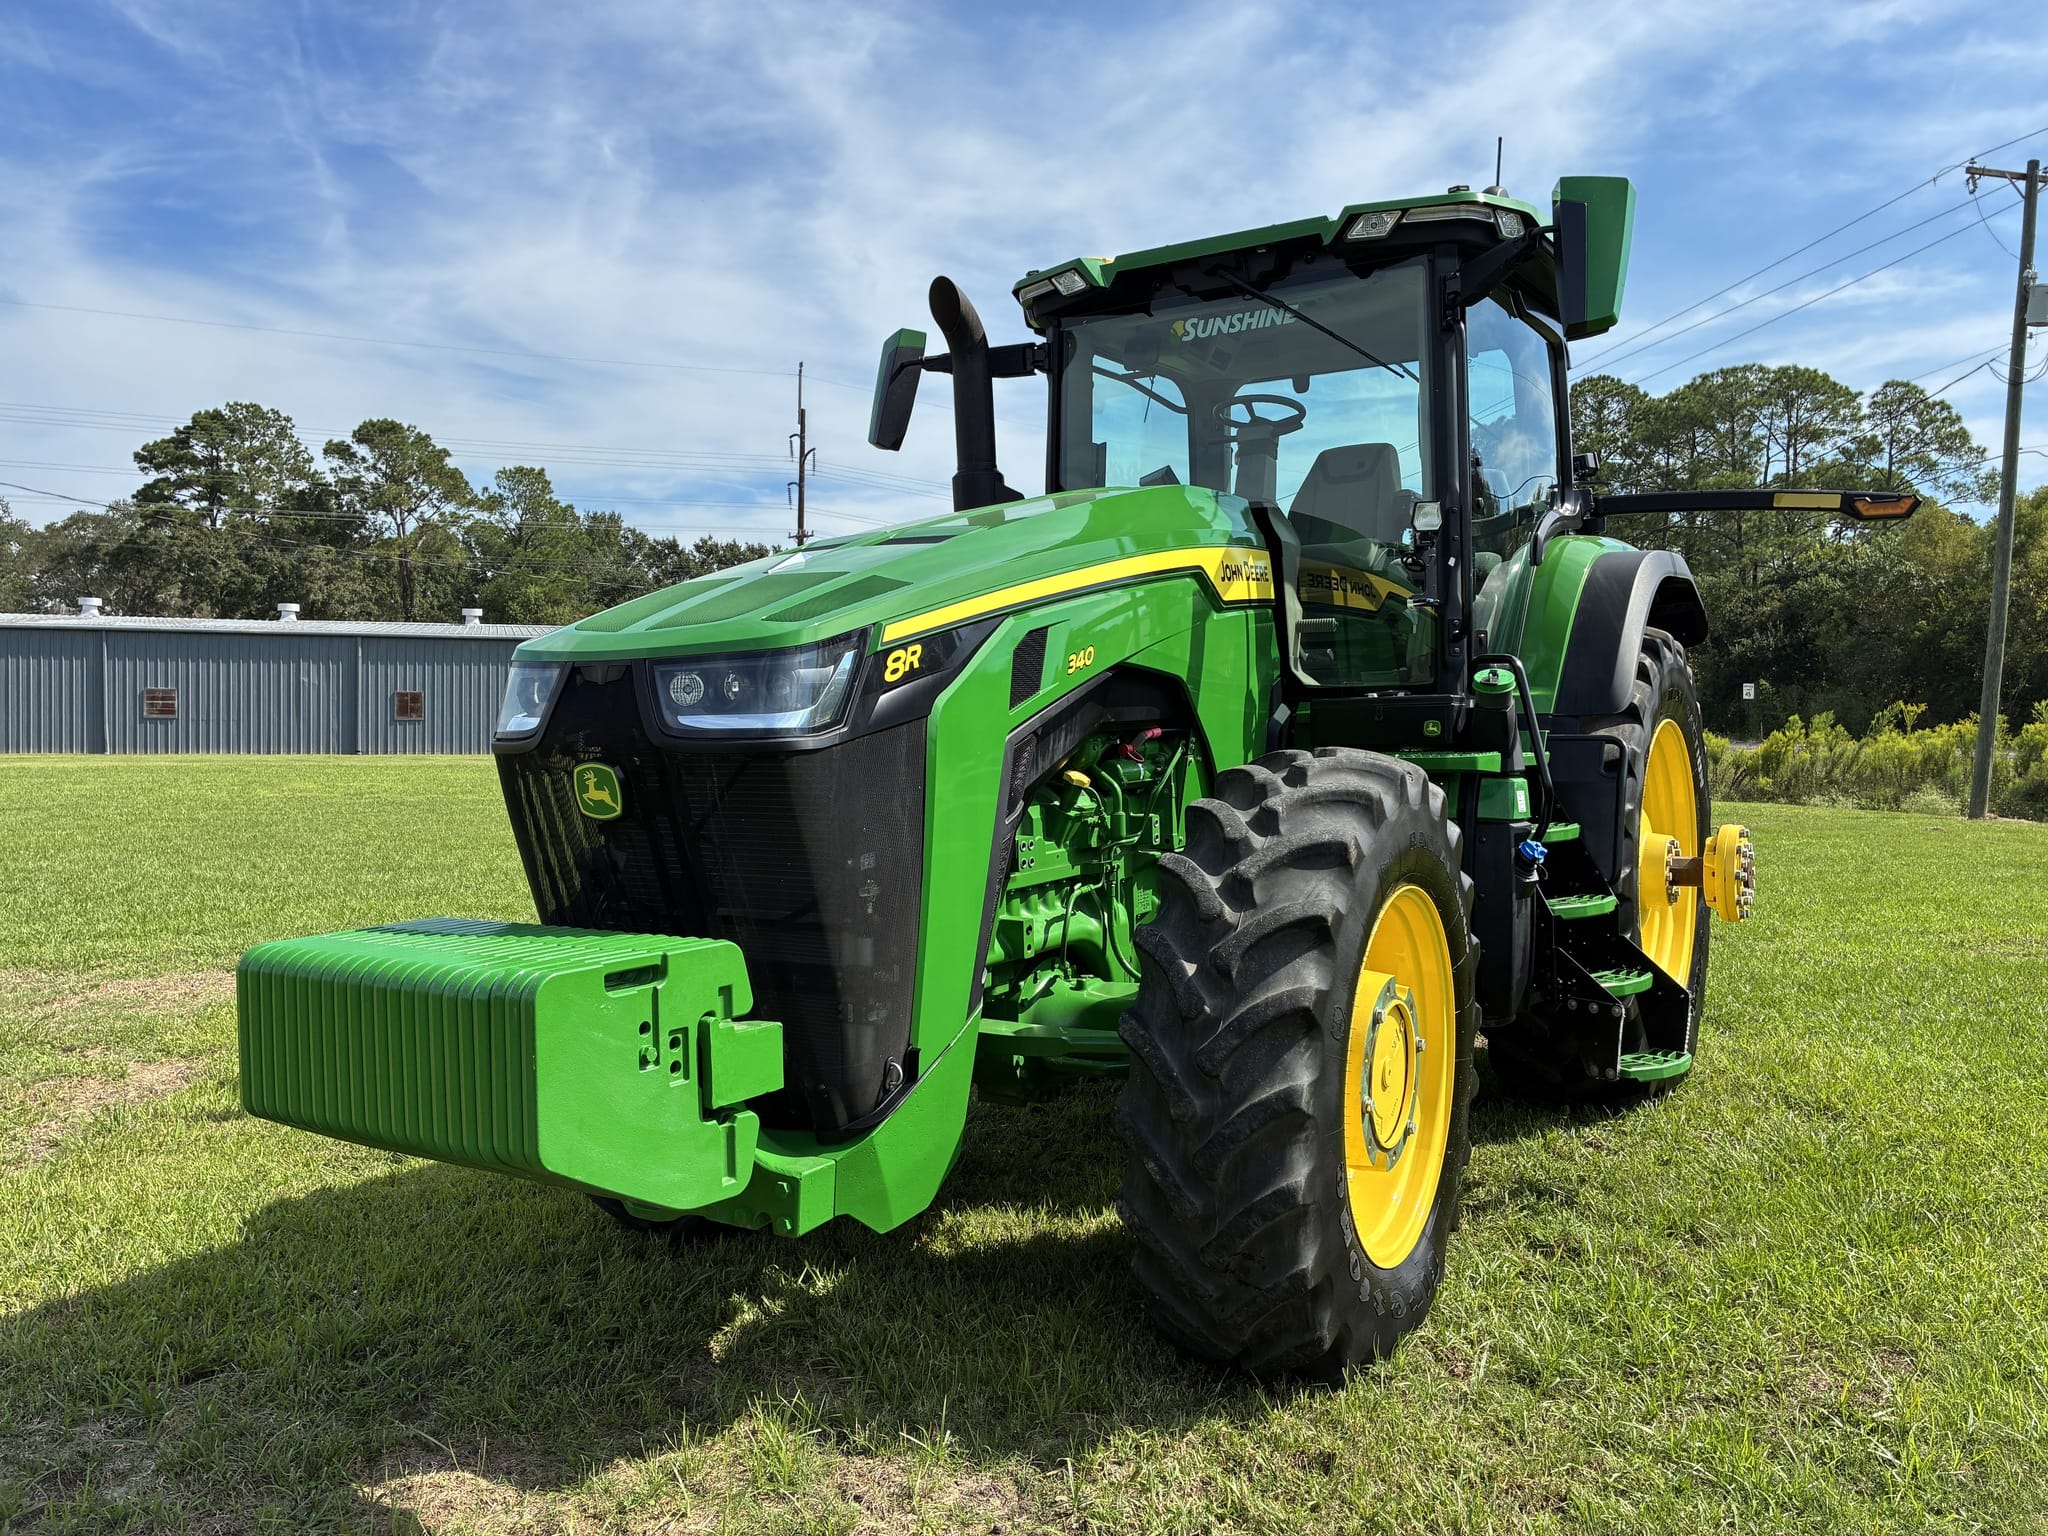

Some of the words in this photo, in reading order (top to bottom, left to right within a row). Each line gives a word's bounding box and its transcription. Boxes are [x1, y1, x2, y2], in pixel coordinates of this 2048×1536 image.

[1221, 560, 1243, 582] JOHN
[1243, 561, 1269, 583] DEERE
[884, 643, 922, 683] 8R
[1067, 645, 1096, 675] 340
